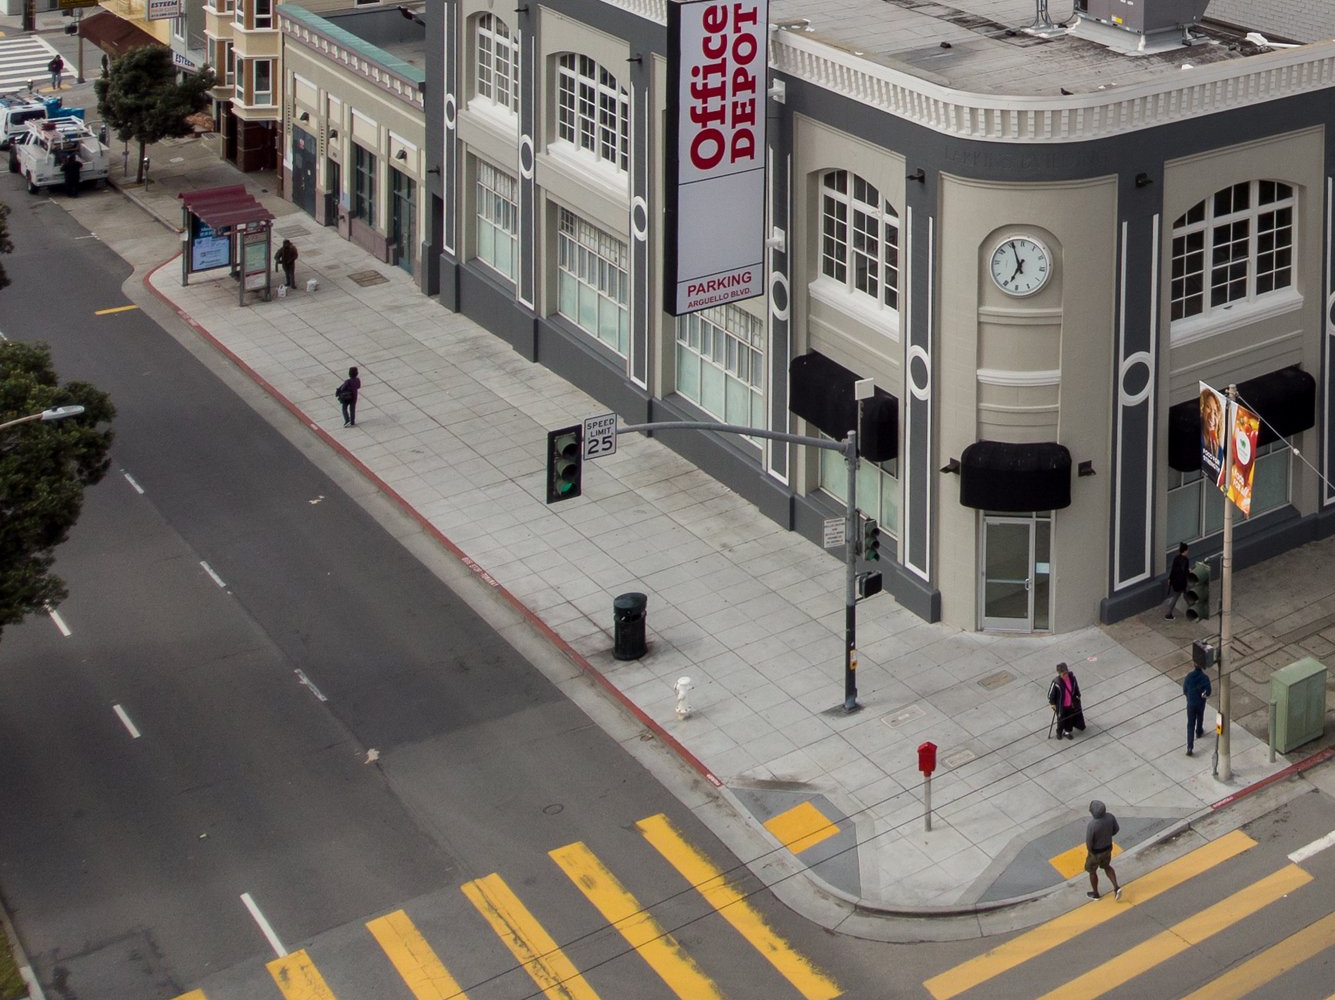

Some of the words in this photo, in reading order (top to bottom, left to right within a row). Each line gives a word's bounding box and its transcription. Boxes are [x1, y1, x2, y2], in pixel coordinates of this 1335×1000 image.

[151, 0, 177, 8] ESTEEM
[690, 4, 728, 170] Office
[730, 3, 758, 164] DEPOT
[687, 271, 752, 297] PARKING
[687, 292, 729, 309] ARGUELLO
[730, 287, 752, 299] BLVD.
[587, 418, 614, 430] SPEED
[590, 427, 612, 436] LIMIT
[588, 436, 613, 455] 25
